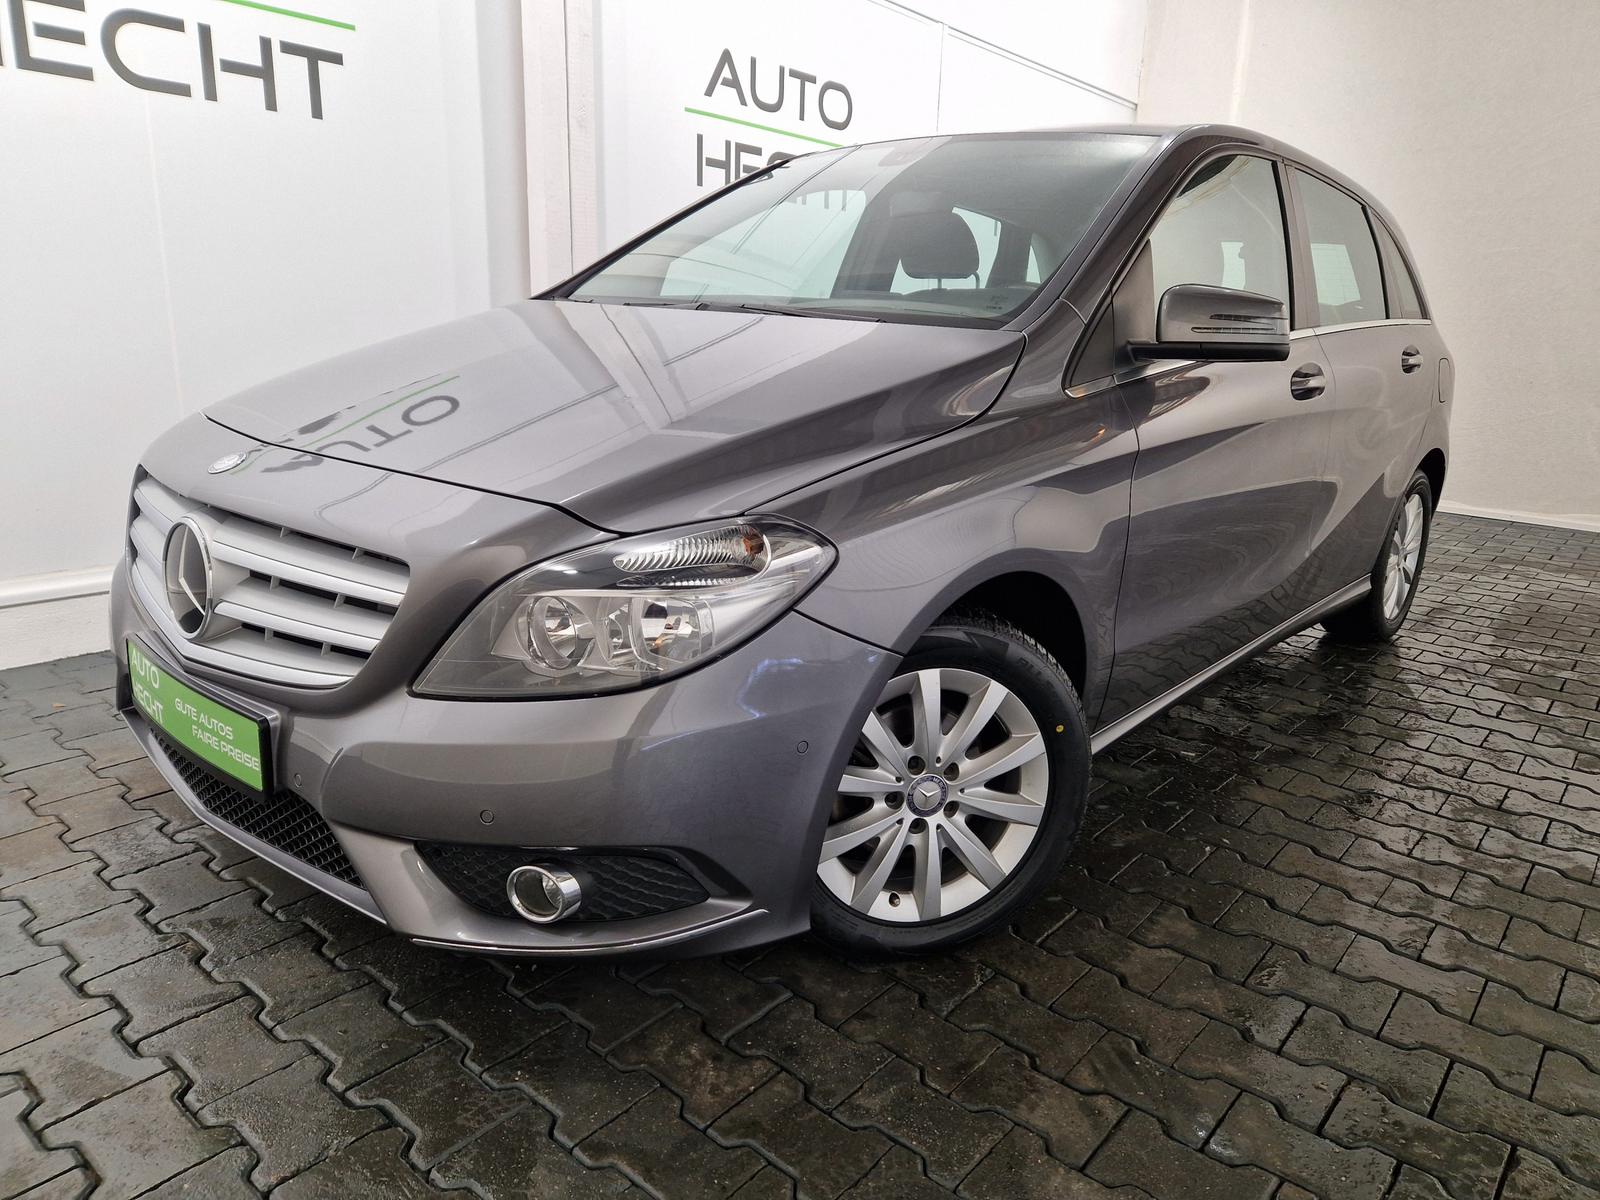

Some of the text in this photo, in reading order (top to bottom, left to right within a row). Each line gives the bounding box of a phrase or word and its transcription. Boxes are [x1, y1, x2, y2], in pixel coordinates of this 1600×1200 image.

[0, 0, 344, 120] ECHT
[704, 48, 853, 131] AUTO
[131, 648, 160, 689] AUTO
[174, 697, 234, 741] GUTE AUTOS
[191, 724, 260, 771] FAIRE PREISE
